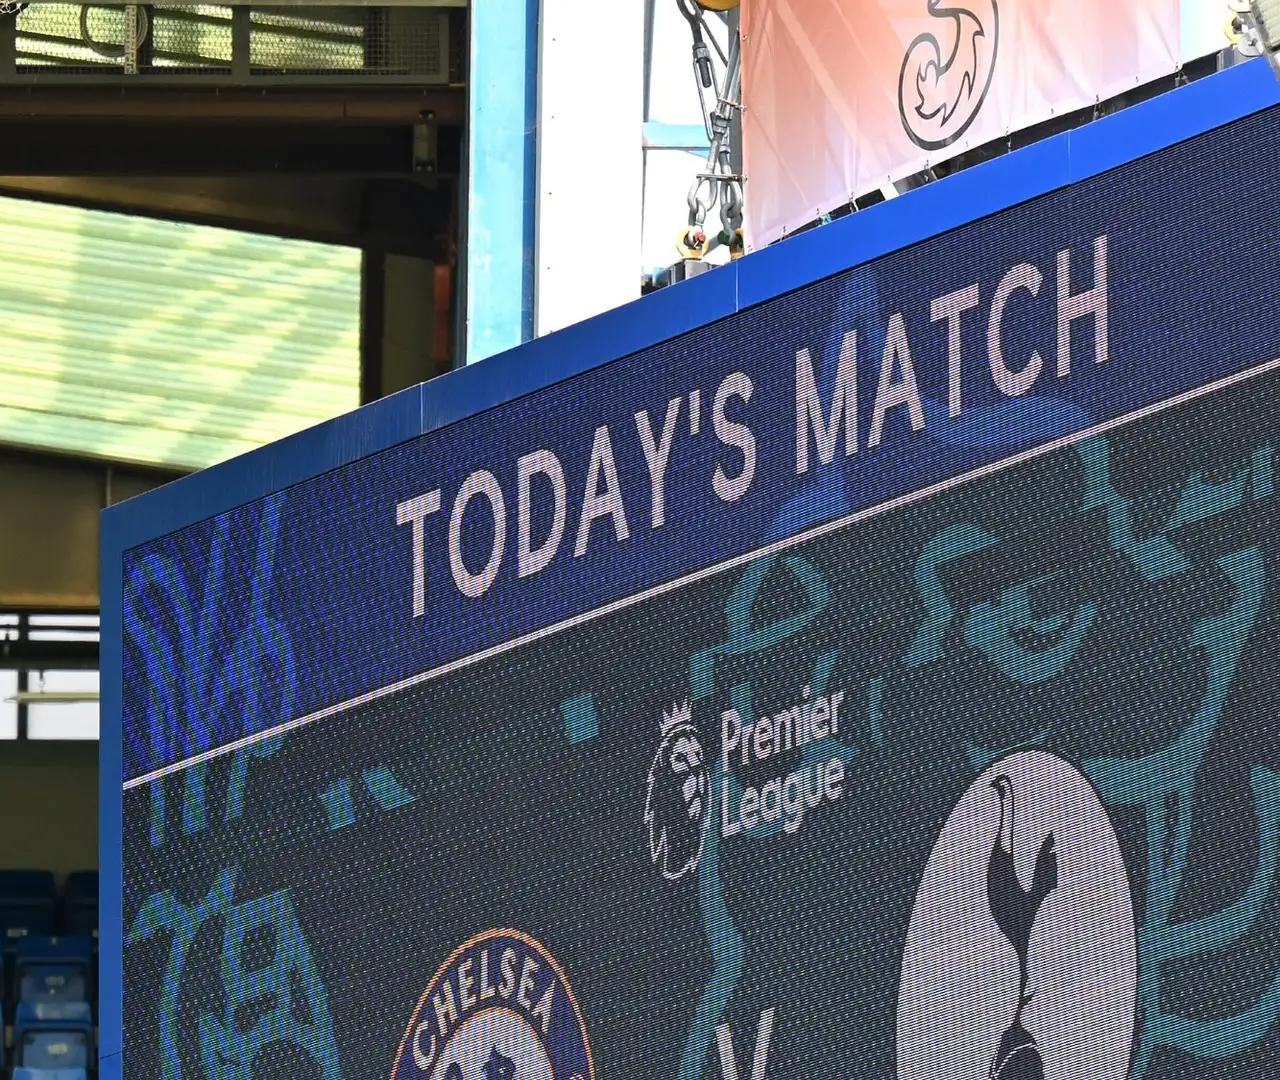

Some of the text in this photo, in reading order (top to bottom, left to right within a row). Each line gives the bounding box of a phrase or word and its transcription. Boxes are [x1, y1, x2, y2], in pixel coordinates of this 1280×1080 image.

[396, 235, 1109, 617] TODAY'S MATCH
[721, 685, 844, 771] Premier
[722, 757, 845, 838] League
[413, 948, 556, 1070] CHELSEA
